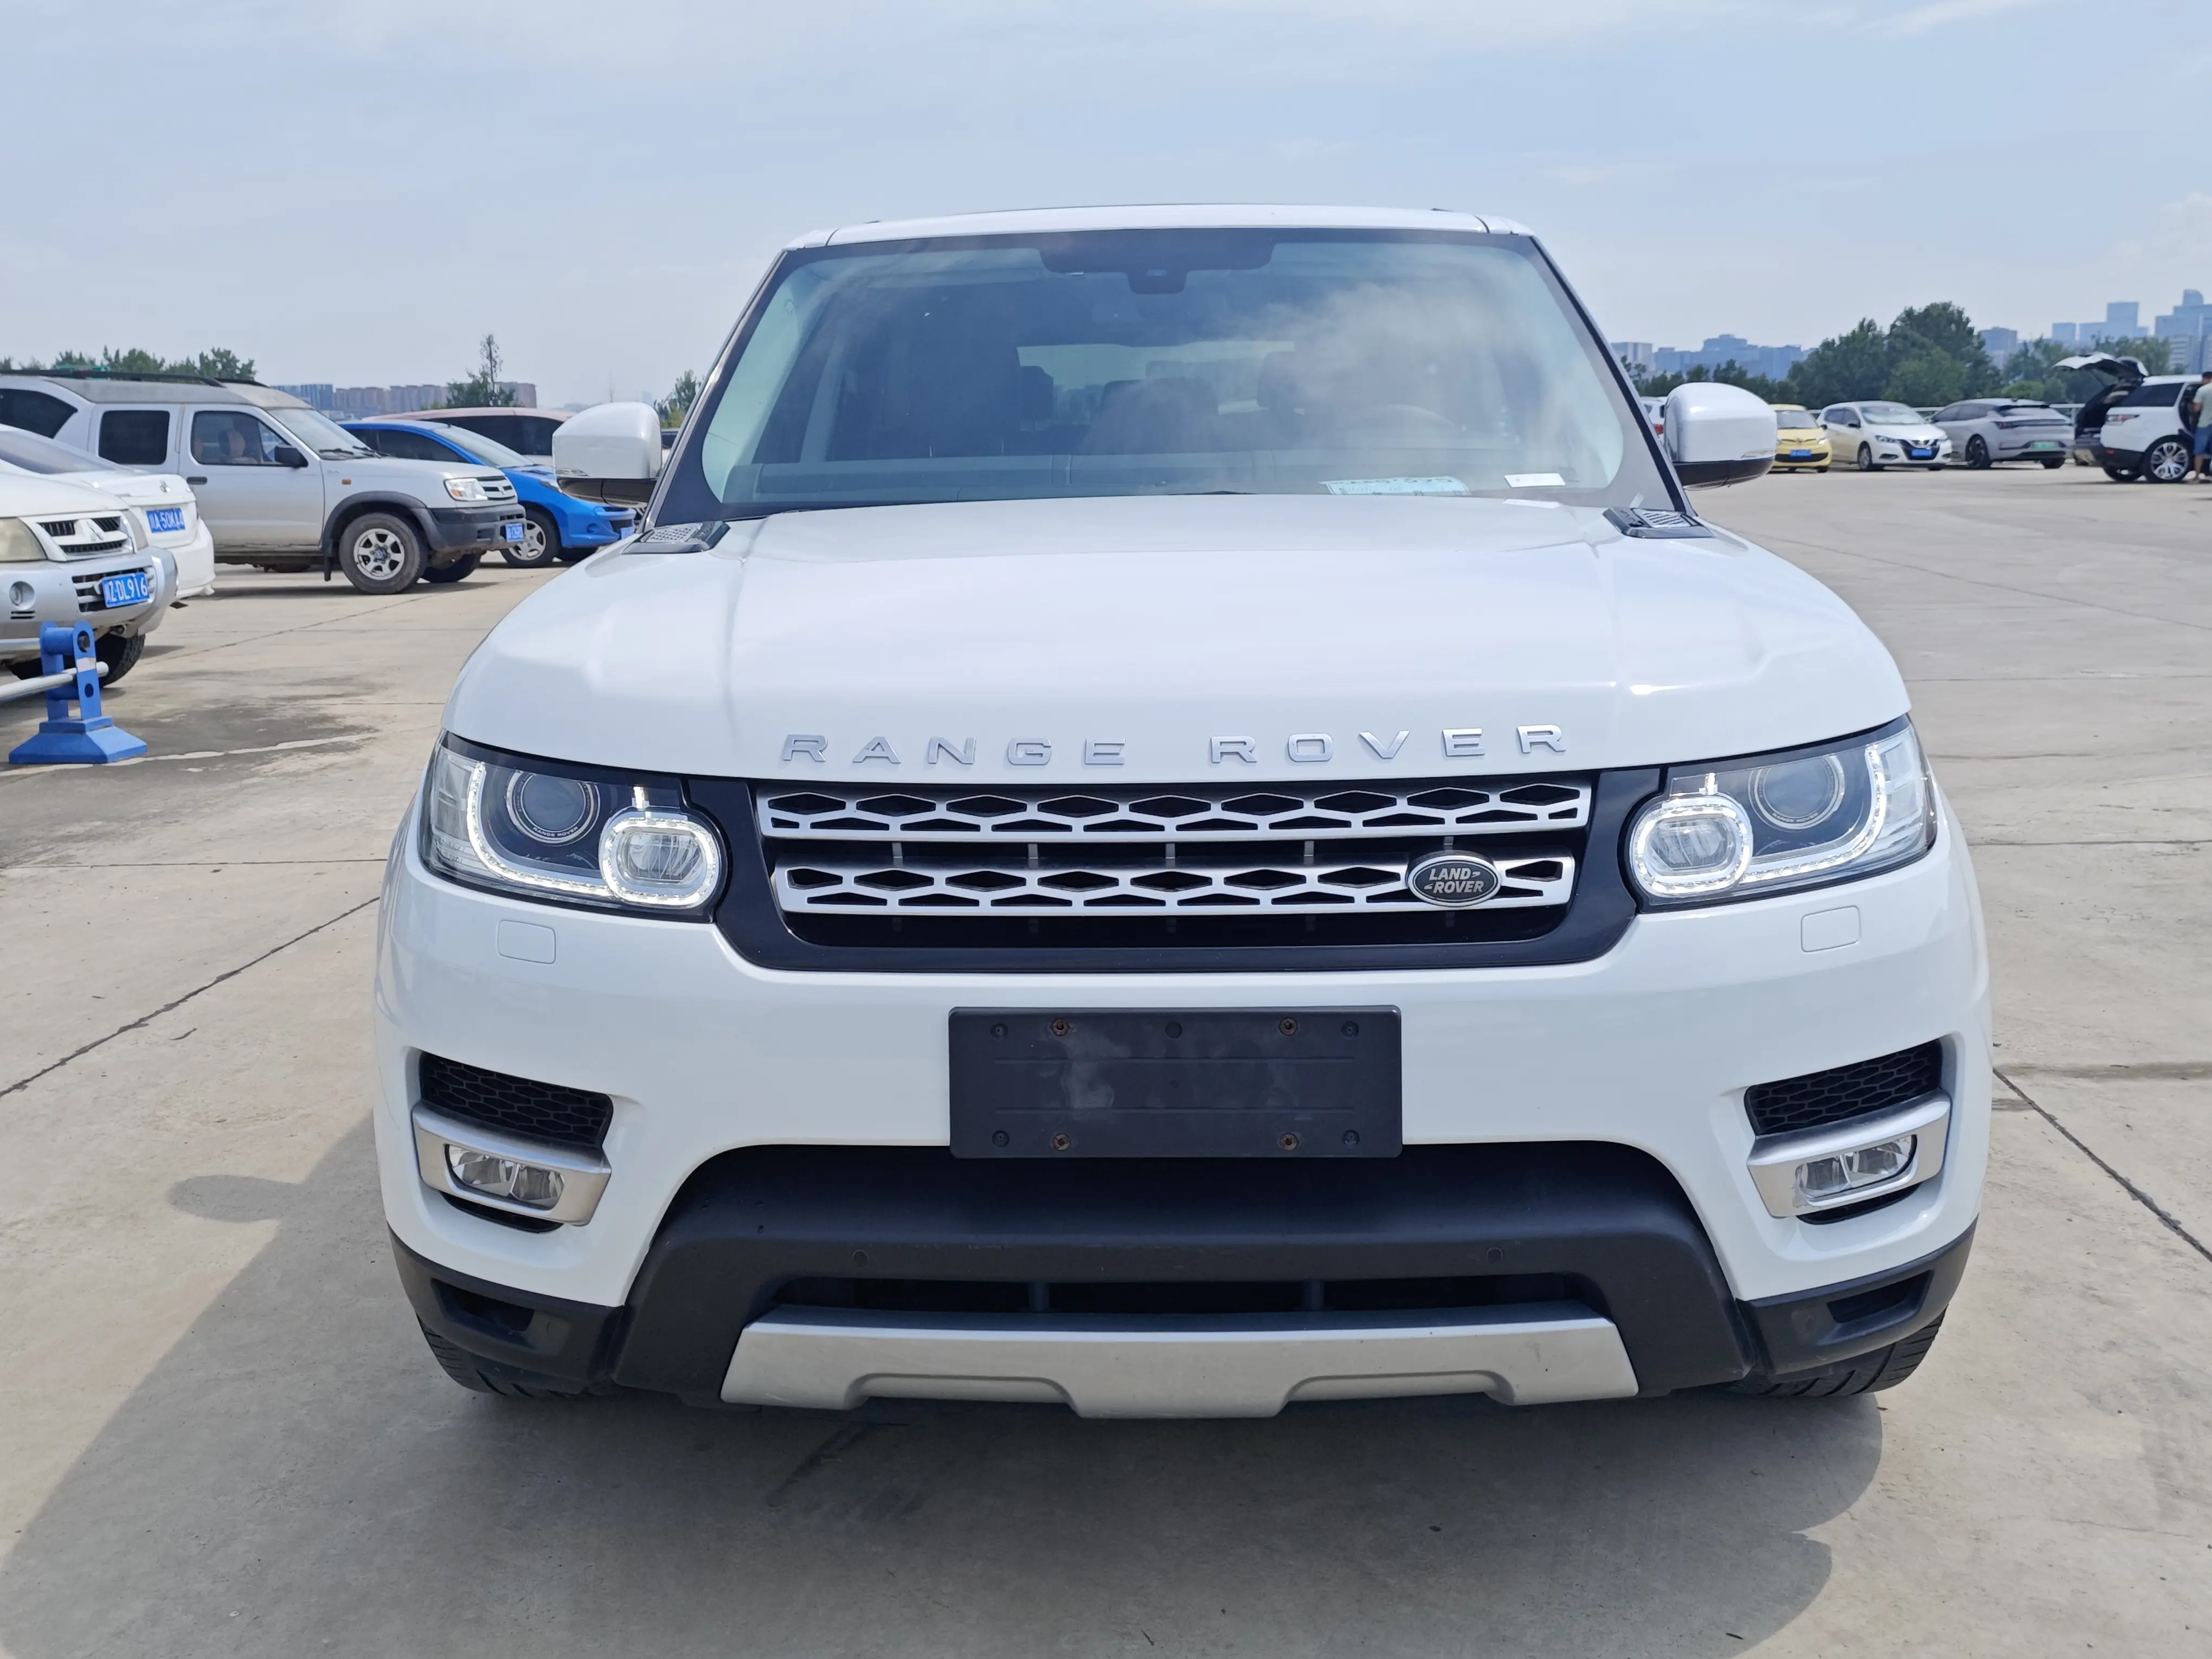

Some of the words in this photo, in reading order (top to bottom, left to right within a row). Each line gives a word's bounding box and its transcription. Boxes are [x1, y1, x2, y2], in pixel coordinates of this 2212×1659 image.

[782, 734, 1126, 766] RANGE
[1210, 724, 1566, 764] ROVER
[532, 827, 556, 837] RANGE
[557, 826, 578, 837] ROVER
[1429, 868, 1471, 880] LAND
[1433, 880, 1484, 893] ROVER
